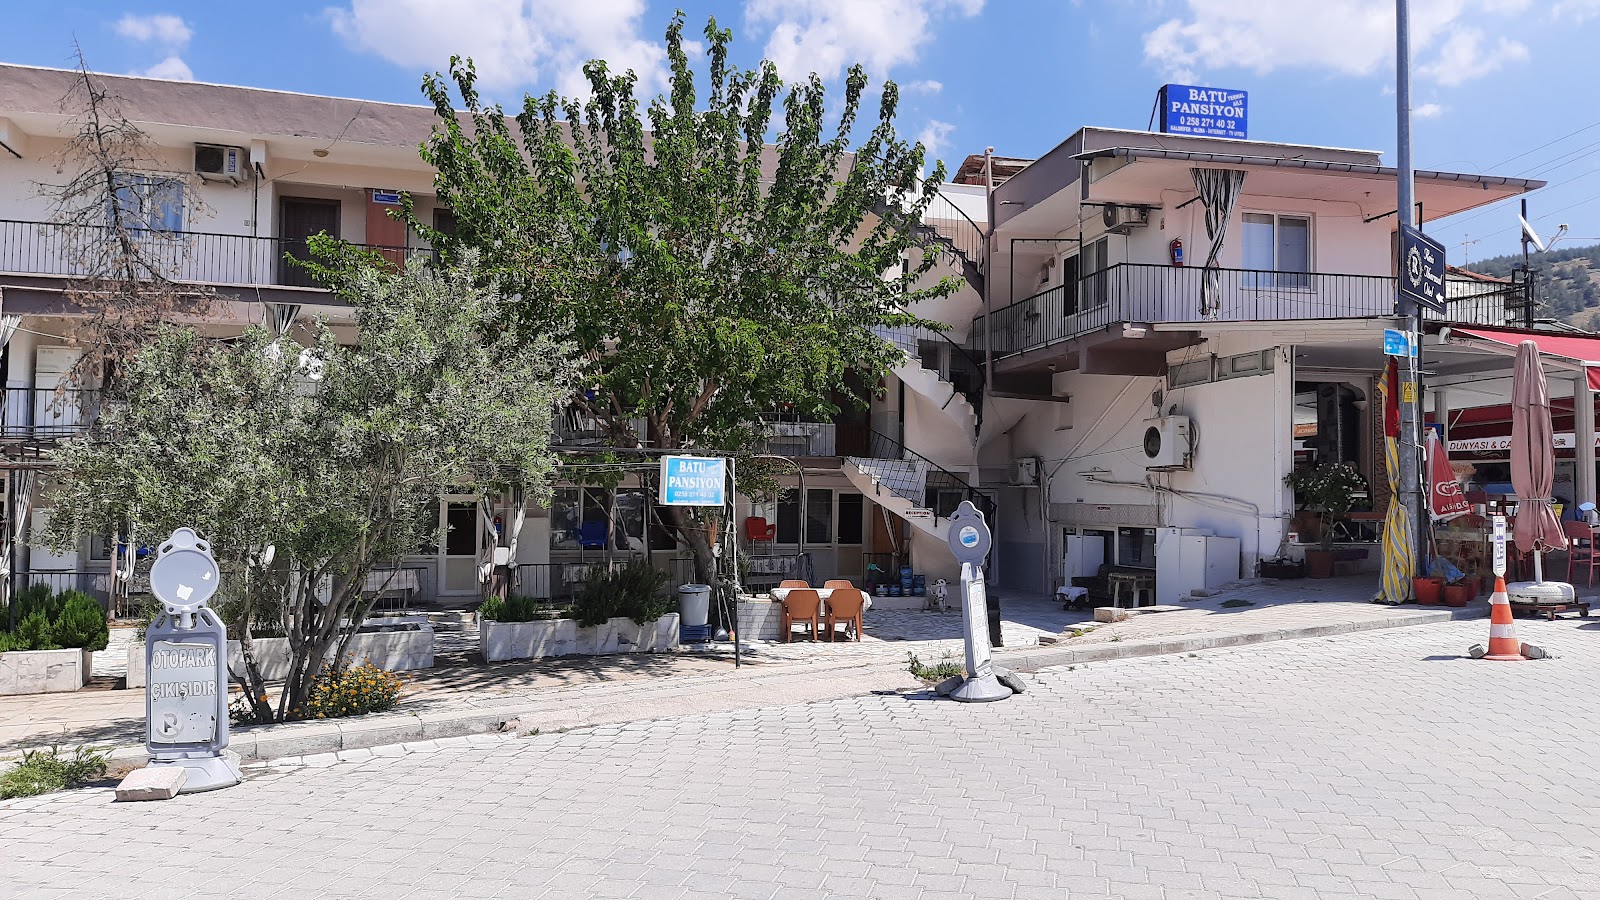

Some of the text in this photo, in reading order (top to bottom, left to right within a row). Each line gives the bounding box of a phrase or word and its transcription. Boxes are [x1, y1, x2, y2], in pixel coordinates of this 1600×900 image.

[1189, 89, 1227, 103] BATU
[1172, 102, 1244, 118] PANSİYON
[1180, 116, 1236, 130] 0 258 271 40 32
[1450, 440, 1488, 450] DÜNYASI
[1490, 441, 1496, 449] &
[680, 461, 706, 472] BATU
[668, 474, 721, 488] PANSİYON
[152, 648, 216, 669] OTOPARK
[152, 680, 216, 702] ÇIKIŞIDIR
